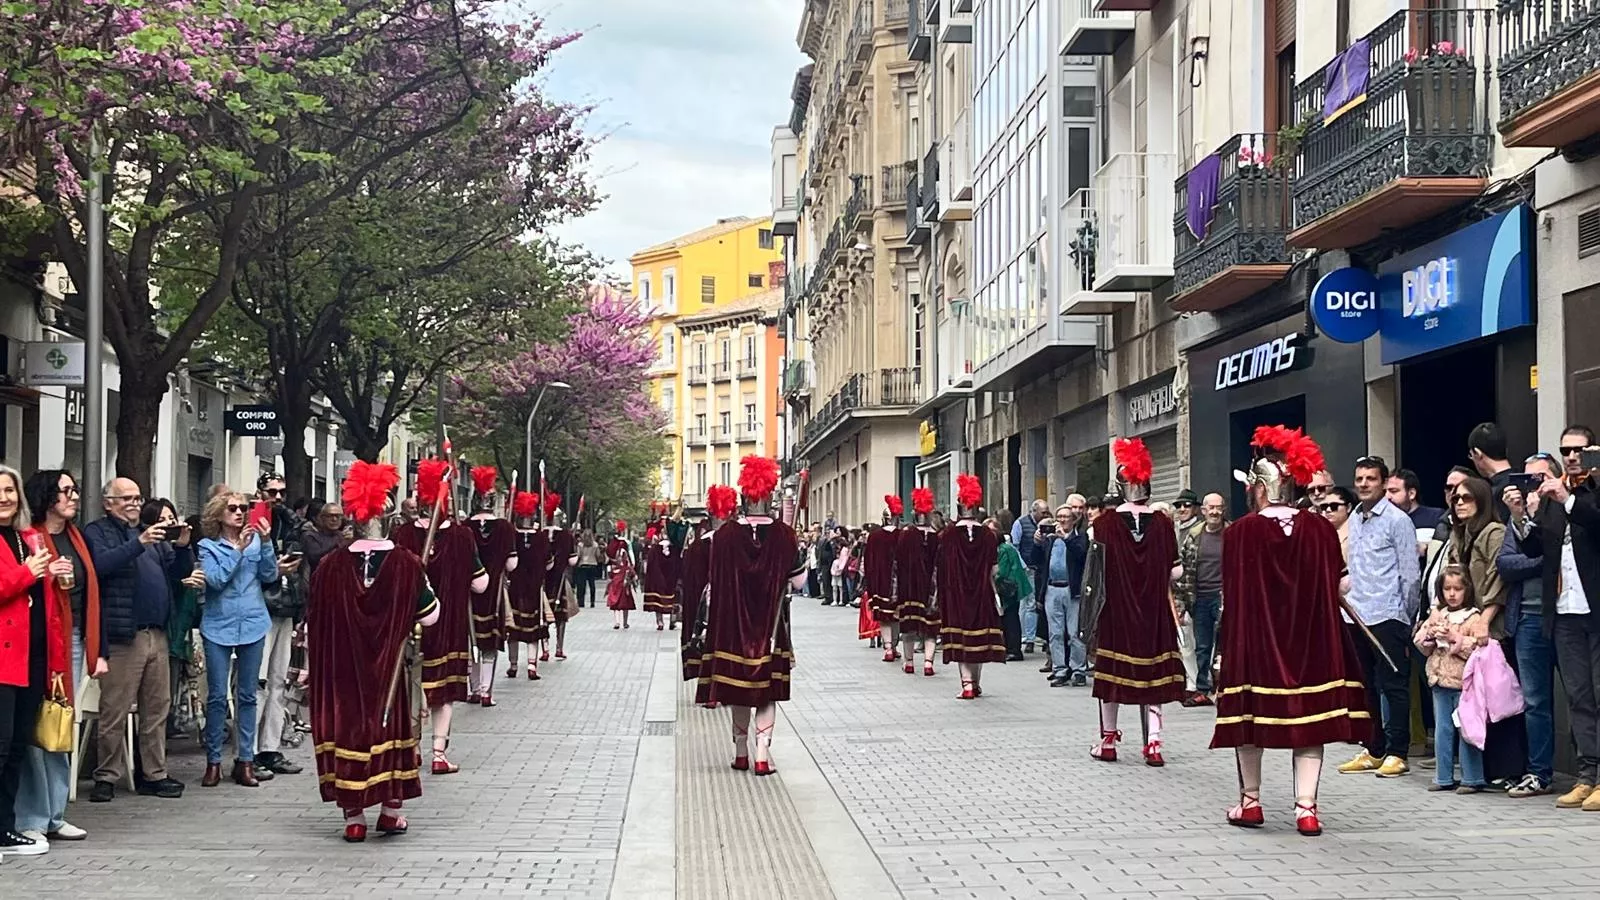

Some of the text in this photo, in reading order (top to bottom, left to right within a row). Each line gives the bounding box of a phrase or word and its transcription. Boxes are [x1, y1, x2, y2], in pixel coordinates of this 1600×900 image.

[1402, 257, 1448, 317] DIGI
[1326, 291, 1376, 310] DIGI
[1215, 332, 1298, 391] DECIMAS
[236, 411, 276, 420] COMPRO
[245, 422, 267, 431] ORO
